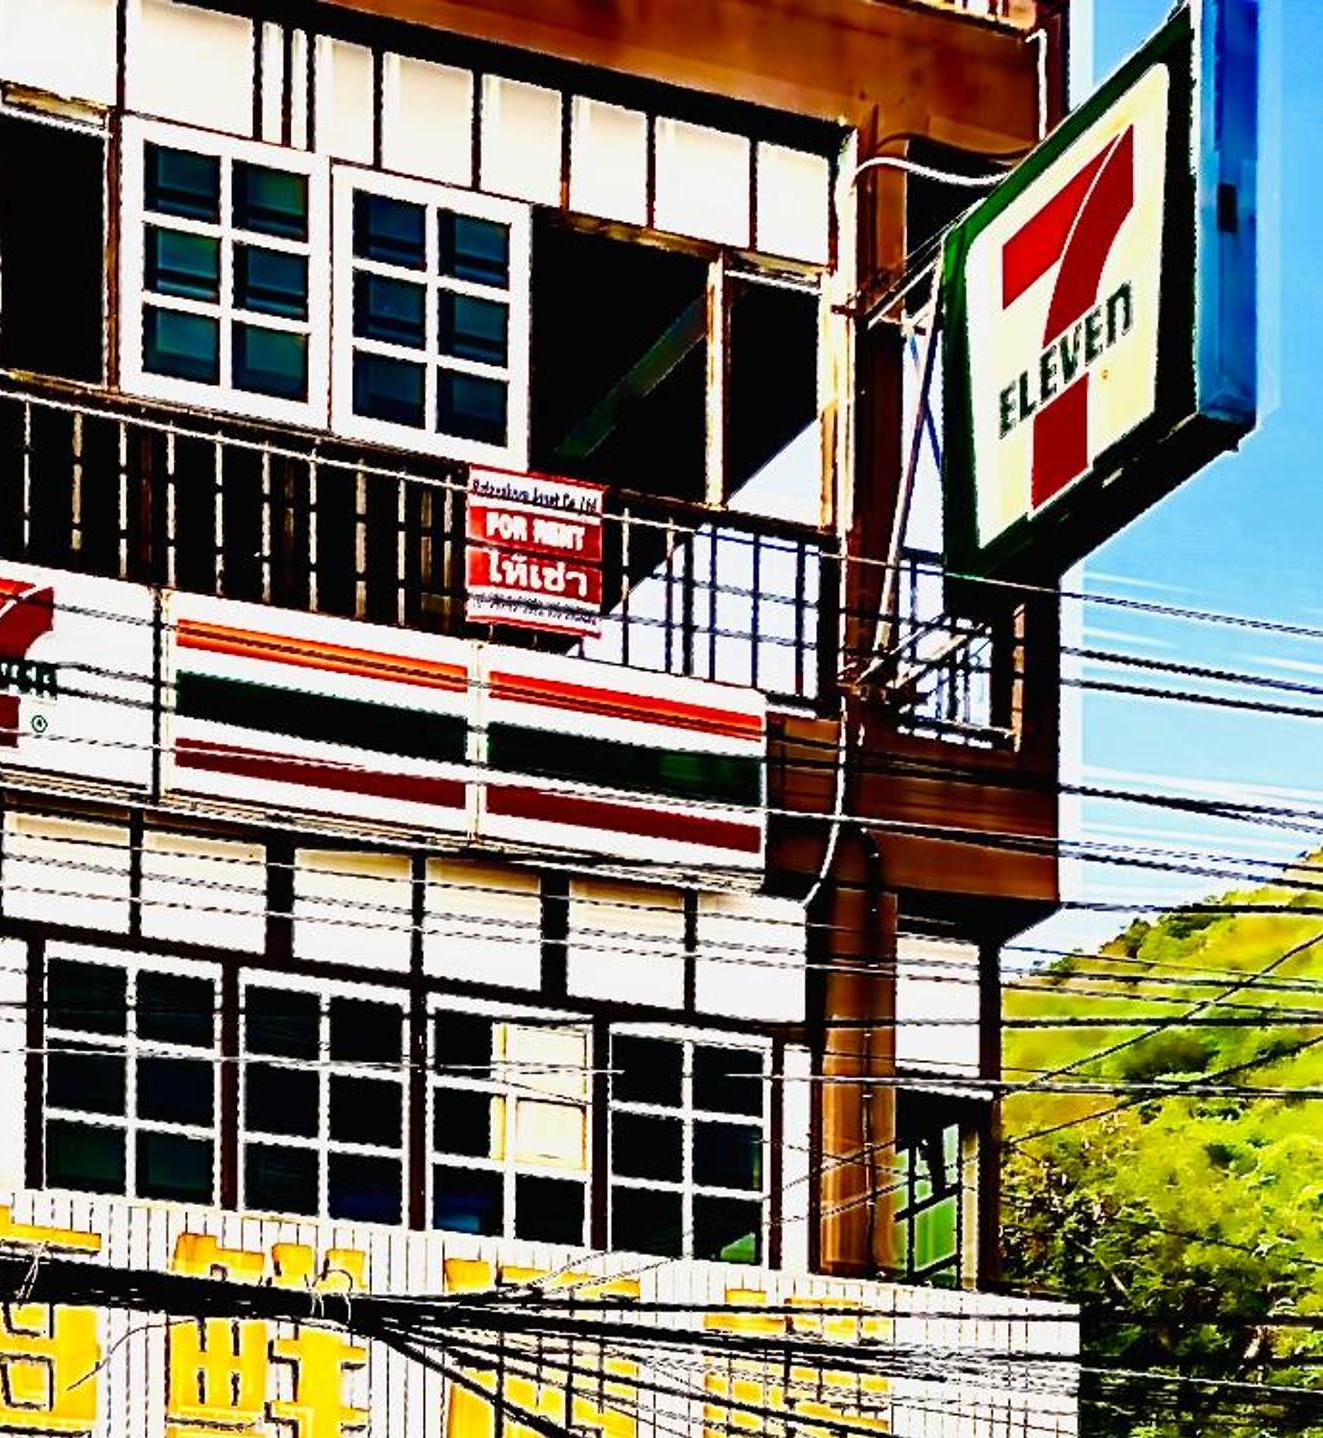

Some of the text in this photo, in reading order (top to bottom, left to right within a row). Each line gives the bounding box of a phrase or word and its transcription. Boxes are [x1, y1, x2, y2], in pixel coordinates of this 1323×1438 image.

[1002, 124, 1134, 511] 7
[486, 511, 586, 551] FOR RENT
